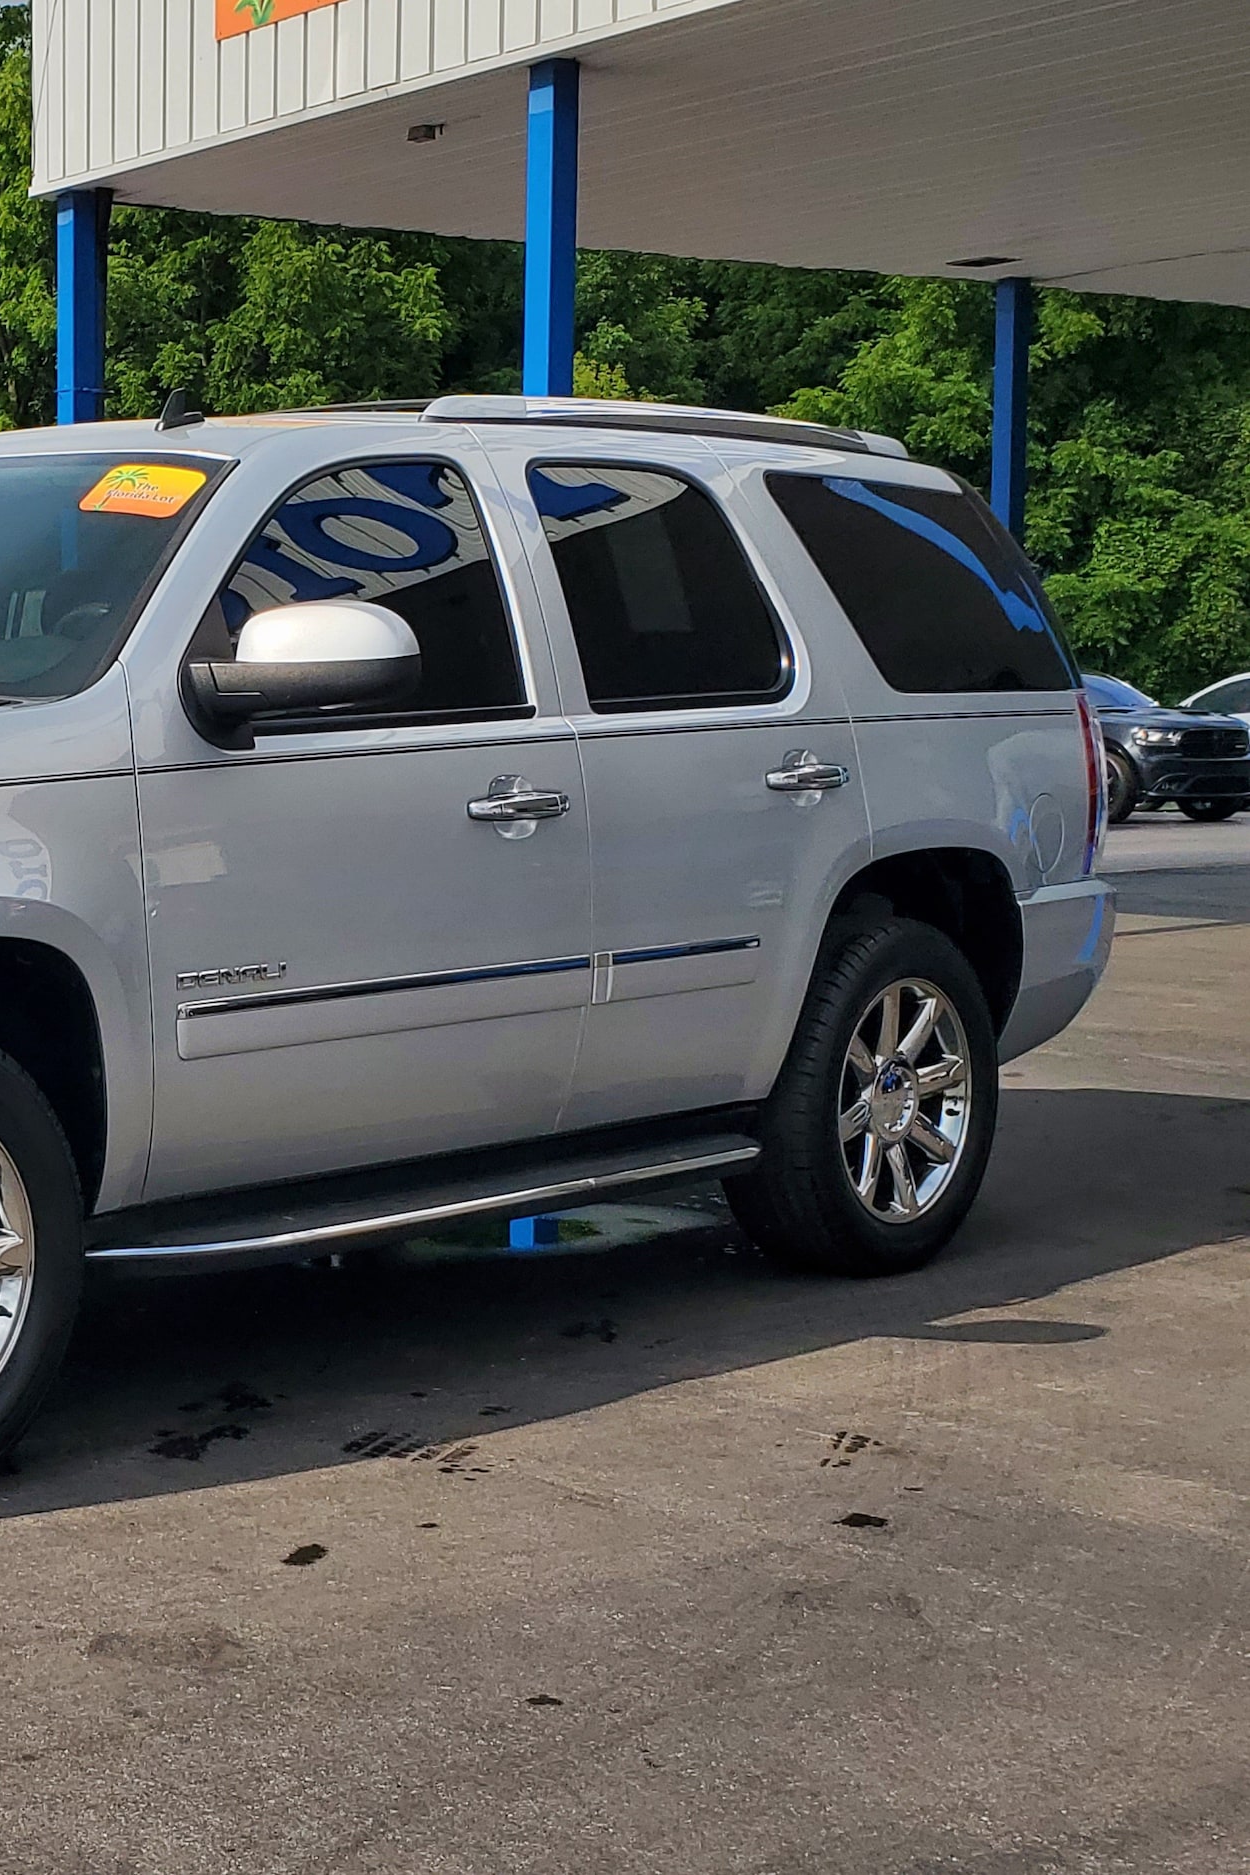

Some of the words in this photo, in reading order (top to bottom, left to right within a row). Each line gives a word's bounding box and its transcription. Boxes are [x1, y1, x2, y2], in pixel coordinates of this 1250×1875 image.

[136, 482, 159, 491] The
[107, 489, 149, 500] Florida
[152, 494, 175, 503] Lot
[176, 961, 287, 991] DENALI
